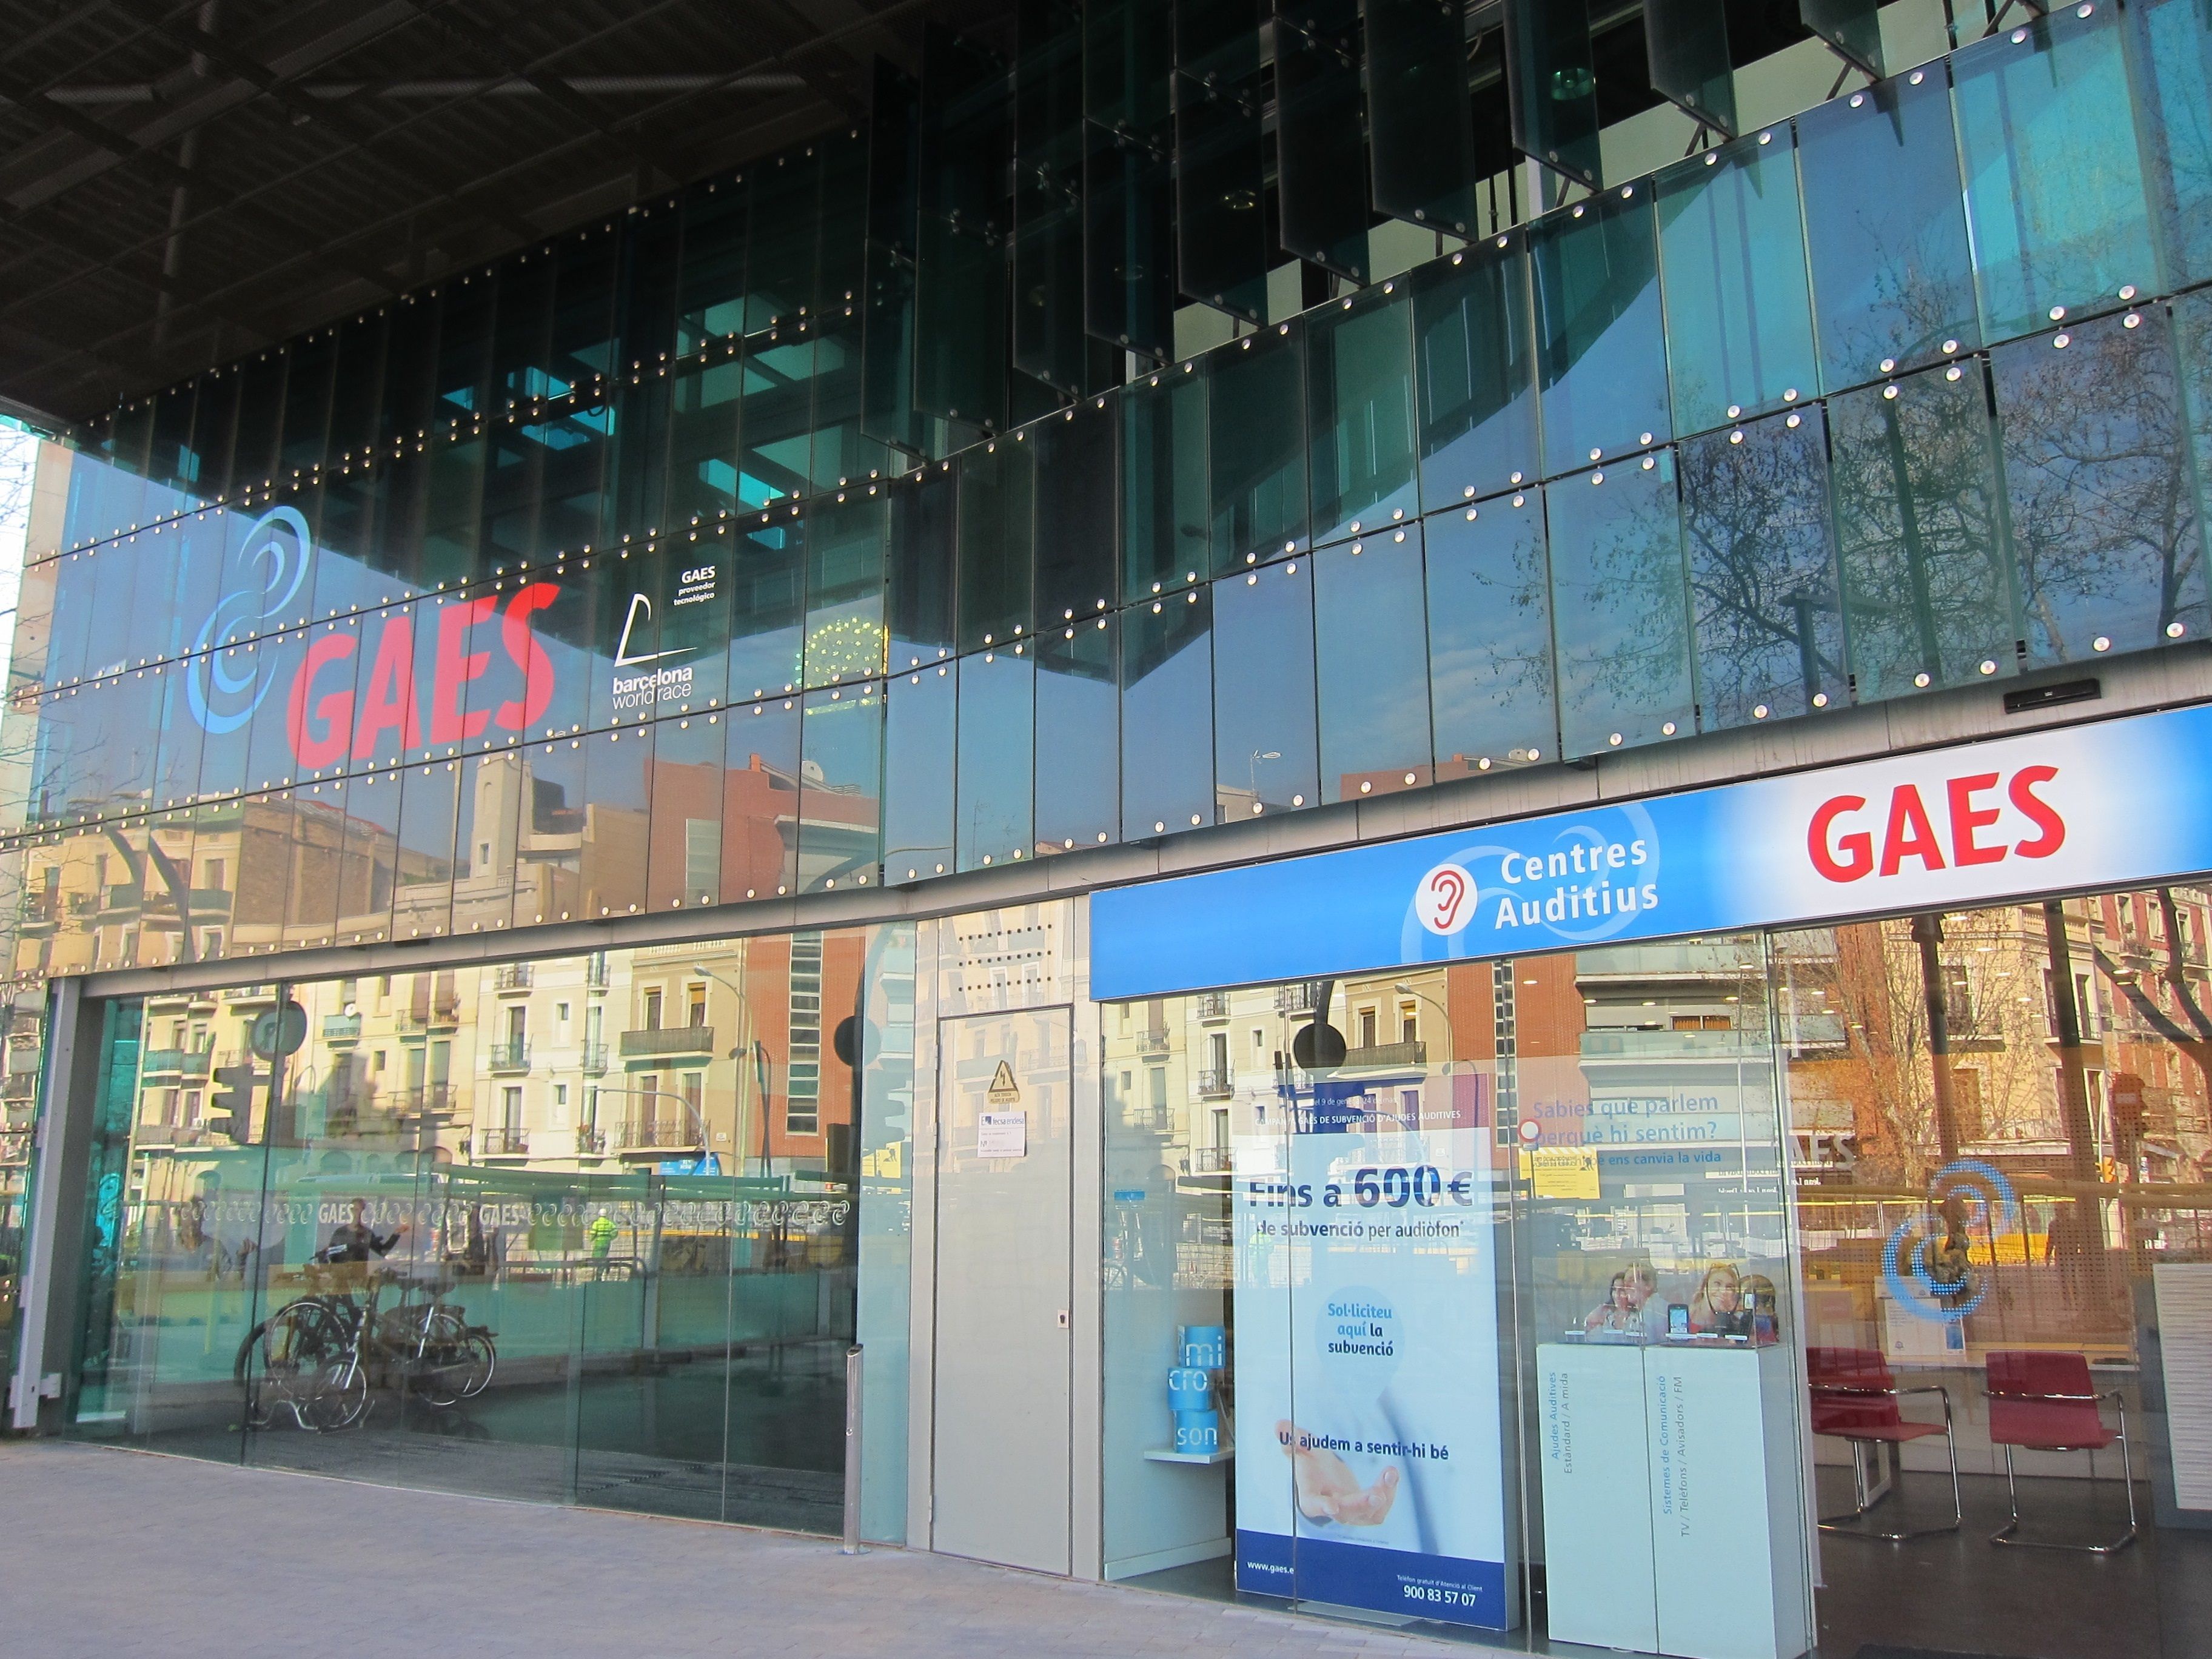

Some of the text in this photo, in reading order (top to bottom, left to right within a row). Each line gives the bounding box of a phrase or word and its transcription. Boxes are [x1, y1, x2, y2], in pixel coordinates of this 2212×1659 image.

[681, 565, 716, 584] GAES
[673, 592, 716, 606] tecnológico
[678, 581, 716, 597] proveedor
[286, 582, 561, 770] GAES
[612, 667, 693, 695] barcelona
[1807, 765, 2066, 883] GAES
[1501, 839, 1648, 884] Centres
[1494, 880, 1659, 930] Auditius
[1327, 1097, 1335, 1105] de
[1533, 1093, 1718, 1120] Sabies que parlem
[1299, 1113, 1318, 1125] GAES
[1319, 1116, 1330, 1125] DE
[1331, 1112, 1376, 1125] SUBVENCIÓ
[1377, 1111, 1416, 1123] D'AJUDES
[1418, 1110, 1461, 1122] AUDITIVES
[1535, 1121, 1717, 1147] perquè hi sentim?
[1609, 1155, 1630, 1166] ens
[1634, 1151, 1674, 1165] canvia
[1677, 1151, 1689, 1164] la
[1693, 1150, 1721, 1163] vida
[1249, 1179, 1313, 1208] Fins
[1323, 1183, 1342, 1208] a
[1353, 1164, 1441, 1208] 600
[318, 1202, 355, 1224] GAES
[479, 1203, 520, 1226] GAES
[1256, 1219, 1276, 1236] de
[1281, 1220, 1364, 1237] subvenció
[1368, 1224, 1391, 1241] per
[1327, 1302, 1393, 1319] Sol·liciteu
[1337, 1320, 1384, 1339] aquí la
[1185, 1335, 1222, 1367] mi
[1327, 1339, 1394, 1357] subvenció
[1168, 1369, 1208, 1392] cro
[1560, 1372, 1569, 1399] mida
[1674, 1376, 1683, 1393] FM
[1549, 1372, 1560, 1460] Ajudes Auditives
[1561, 1402, 1569, 1411] A
[1177, 1427, 1218, 1446] son
[1675, 1404, 1686, 1456] Avisadors
[1279, 1430, 1449, 1460] Us ajudem a sentir-hi bé
[1563, 1421, 1572, 1474] Estàndard
[1659, 1375, 1672, 1514] Sistemes de Comunicació
[1679, 1467, 1689, 1512] Telèfons
[1681, 1522, 1690, 1537] TV
[1247, 1561, 1295, 1575] www.gaes.e
[1404, 1584, 1476, 1607] 900 83 57 07
